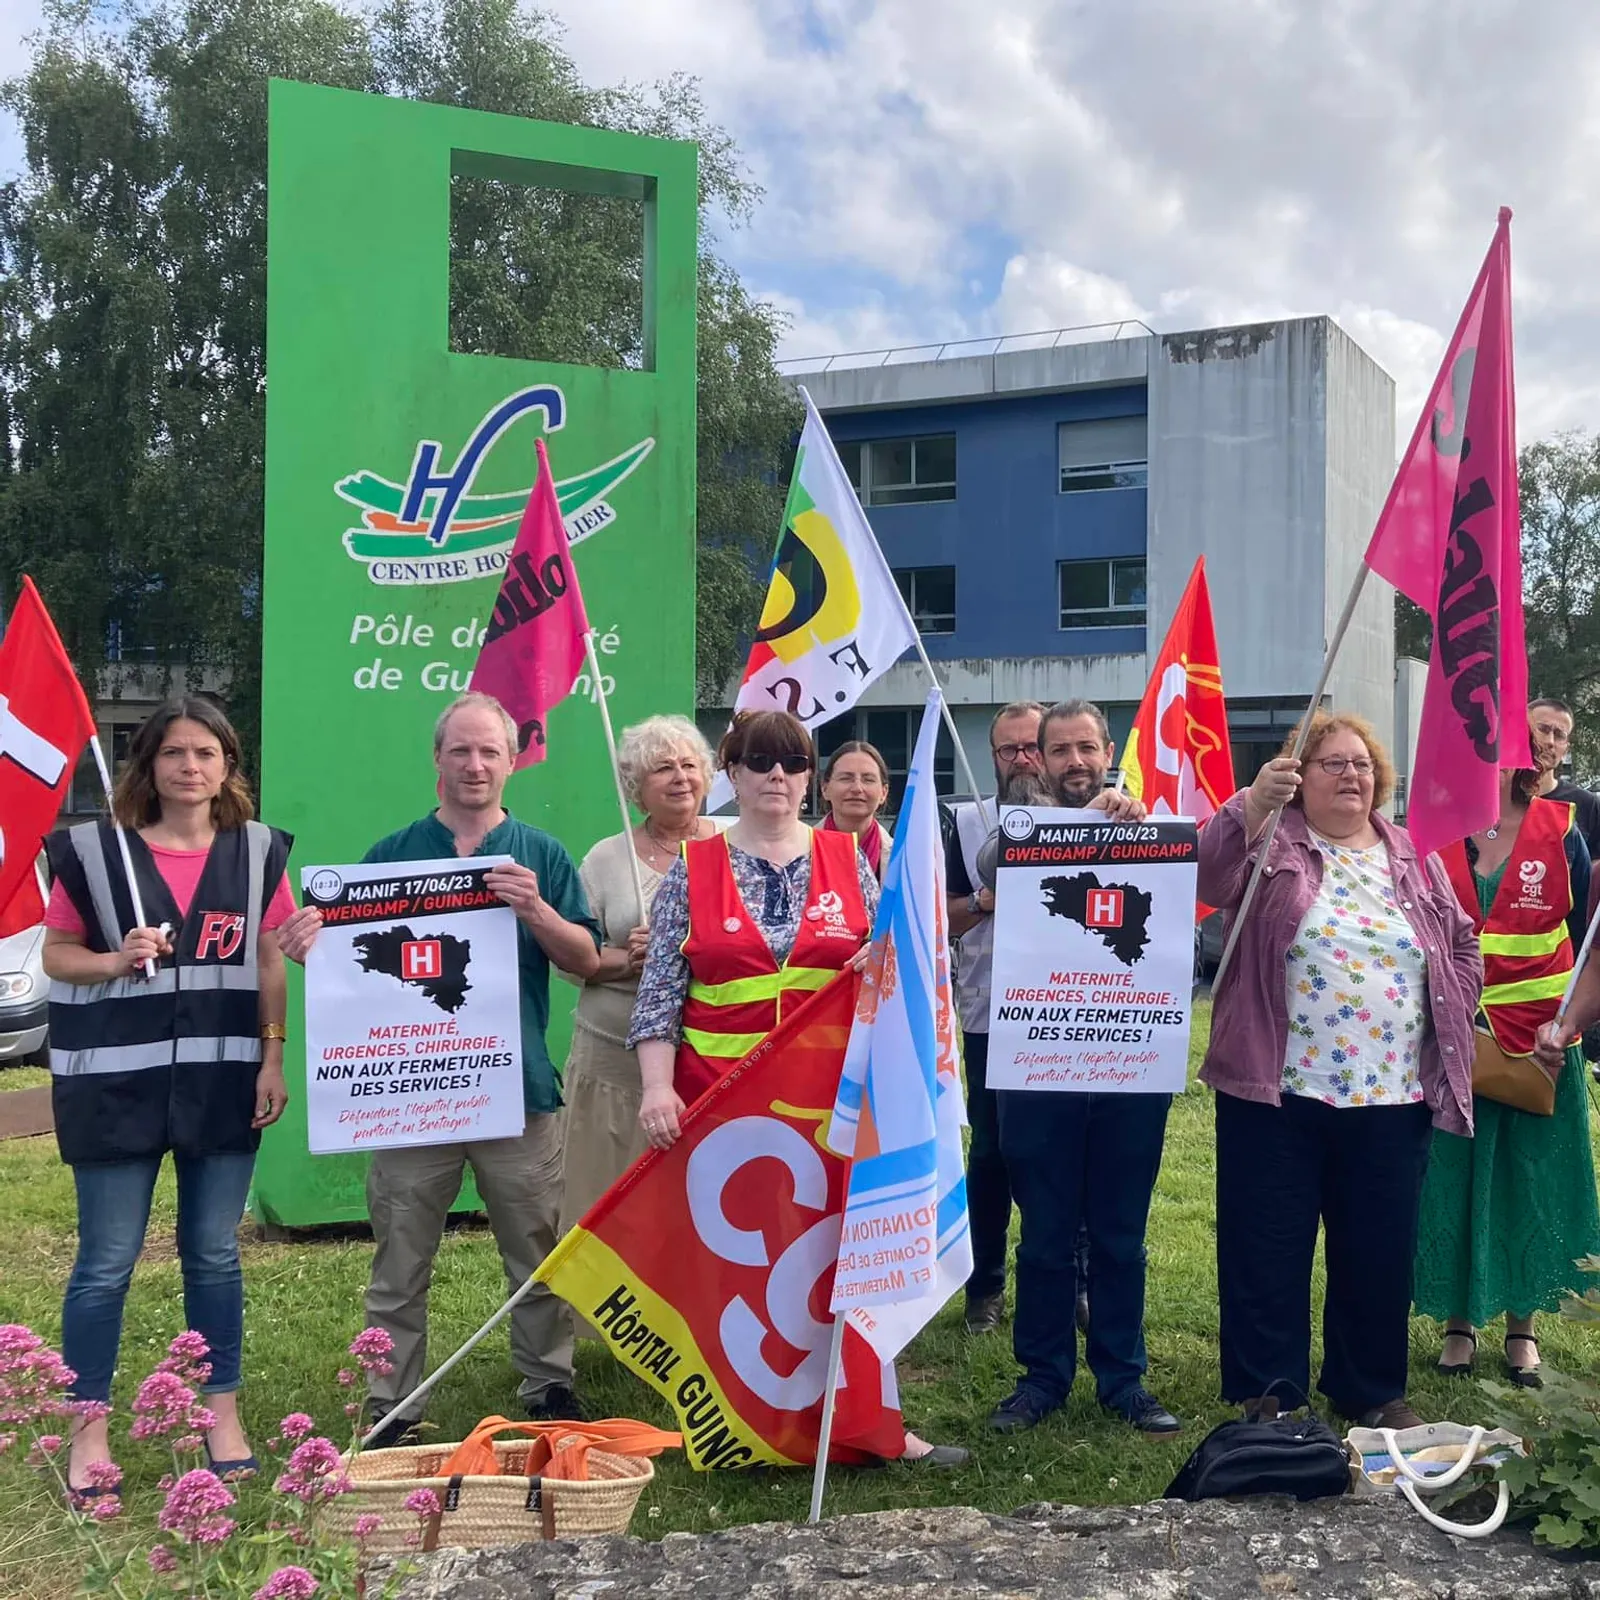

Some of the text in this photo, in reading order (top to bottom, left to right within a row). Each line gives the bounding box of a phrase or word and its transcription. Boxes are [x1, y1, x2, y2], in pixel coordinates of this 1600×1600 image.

[372, 559, 468, 580] CENTRE
[350, 614, 434, 647] Pôle
[353, 658, 403, 690] de
[1038, 826, 1158, 843] MANIF 17/06/23
[1005, 846, 1097, 861] GWENGAMP
[1111, 843, 1192, 860] GUINGAMP
[347, 874, 473, 901] MANIF 17/06/23
[1522, 883, 1543, 897] cgt
[825, 912, 847, 926] cgt
[1049, 970, 1135, 988] MATERNITÉ,
[1005, 988, 1086, 1005] URGENCES,
[1092, 991, 1171, 1005] CHIRURGIE
[997, 1006, 1184, 1026] NON AUX FERMETURES
[369, 1018, 460, 1040] MATERNITÉ,
[1028, 1026, 1060, 1041] DES
[1063, 1027, 1142, 1043] SERVICES
[323, 1043, 410, 1060] URGENCES,
[416, 1036, 497, 1055] CHIRURGIE
[316, 1052, 513, 1081] NON AUX FERMETURES
[1123, 1052, 1160, 1069] public
[350, 1081, 385, 1097] DES
[389, 1074, 471, 1094] SERVICES
[1025, 1067, 1071, 1085] partout
[1071, 1071, 1085, 1081] en
[1088, 1068, 1138, 1085] Bretagne
[455, 1094, 491, 1111] public
[352, 1122, 400, 1143] partout
[402, 1121, 415, 1133] en
[417, 1115, 471, 1134] Bretagne
[593, 1284, 681, 1384] HÔPITAL
